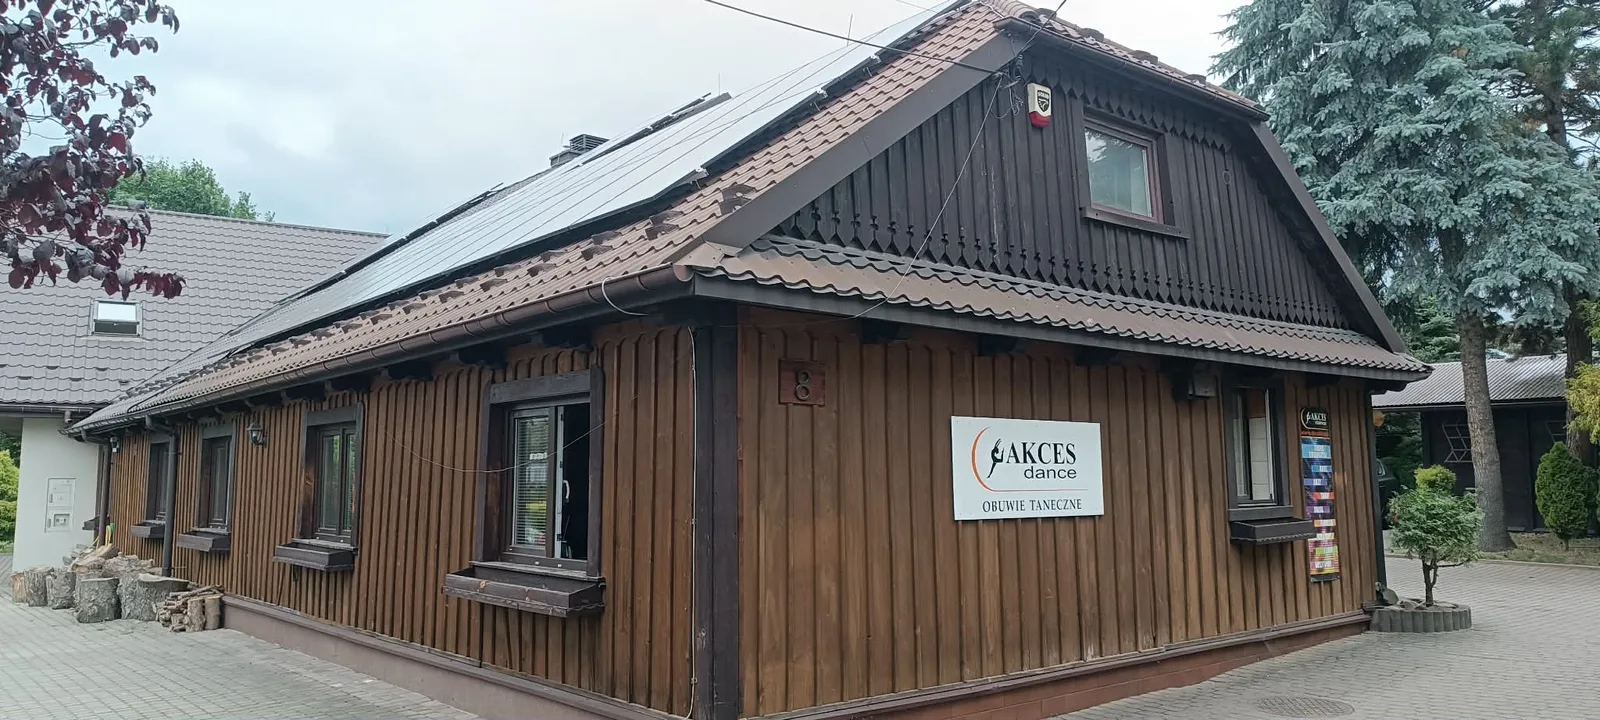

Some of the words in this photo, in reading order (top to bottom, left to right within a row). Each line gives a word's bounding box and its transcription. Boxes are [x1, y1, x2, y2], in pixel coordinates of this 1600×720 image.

[795, 369, 811, 401] 8
[1006, 441, 1077, 465] AKCES
[1024, 466, 1077, 479] dance
[982, 499, 1025, 513] OBUWIE
[1029, 499, 1082, 512] TANECZNE
